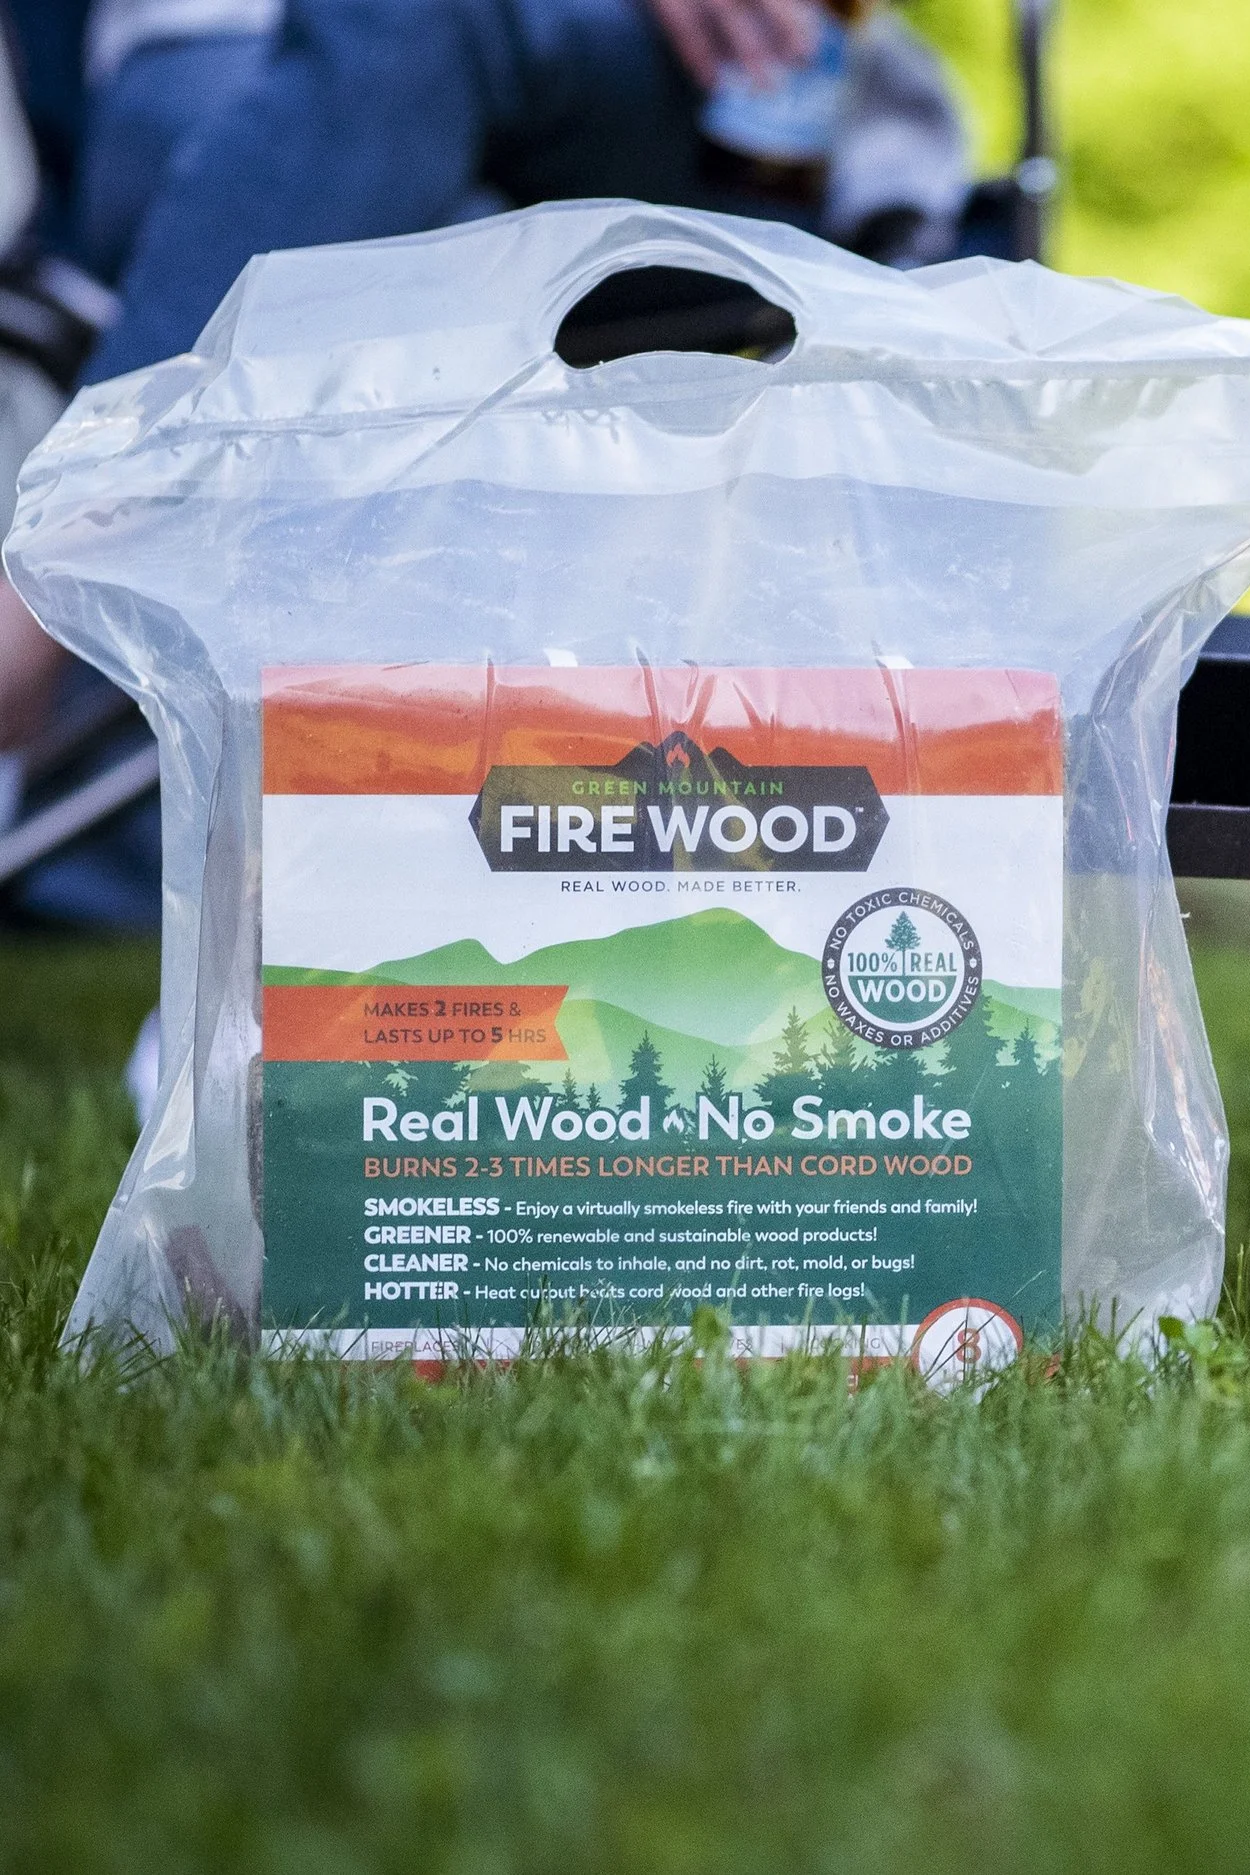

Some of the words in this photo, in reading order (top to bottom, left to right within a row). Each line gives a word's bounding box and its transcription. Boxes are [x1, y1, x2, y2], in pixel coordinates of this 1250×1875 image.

[572, 781, 647, 795] GREEN
[659, 781, 783, 795] MOUNTAIN
[501, 805, 635, 852] FIRE
[561, 881, 604, 892] REAL
[612, 881, 671, 892] WOOD.
[678, 881, 728, 892] MADE
[733, 881, 801, 892] BETTER.
[830, 926, 847, 950] NO
[846, 893, 892, 924] TOXIC
[898, 892, 974, 950] CHEMICALS
[848, 952, 897, 972] 100%
[910, 952, 957, 972] REAL
[857, 979, 946, 1002] WOOD
[364, 1002, 428, 1017] MAKES
[434, 1000, 447, 1017] 2
[452, 1002, 503, 1017] FIRES
[509, 1002, 521, 1016] &
[825, 974, 840, 998] NO
[837, 1001, 884, 1042] WAXES
[891, 1034, 913, 1046] OR
[921, 976, 979, 1043] ADDITIVES
[364, 1029, 422, 1043] LASTS
[428, 1029, 454, 1043] UP
[459, 1029, 485, 1043] TO
[491, 1026, 503, 1043] 5
[508, 1029, 546, 1043] HRS
[363, 1096, 478, 1141] Real
[495, 1096, 650, 1141] Wood
[699, 1095, 774, 1140] No
[791, 1094, 972, 1140] Smoke
[364, 1157, 457, 1178] BURNS
[465, 1157, 503, 1177] 2-3
[509, 1156, 591, 1177] TIMES
[598, 1155, 709, 1177] LONGER
[716, 1155, 792, 1176] THAN
[800, 1155, 878, 1176] CORD
[883, 1155, 973, 1176] WOOD
[364, 1197, 500, 1217] SMOKELESS
[516, 1201, 559, 1219] Enjoy
[563, 1205, 573, 1216] a
[577, 1200, 640, 1219] virtually
[644, 1200, 723, 1215] smokeless
[727, 1200, 753, 1214] fire
[757, 1200, 792, 1214] with
[796, 1203, 830, 1217] your
[833, 1199, 887, 1214] friends
[890, 1199, 921, 1214] and
[925, 1199, 978, 1216] family!
[364, 1226, 471, 1244] GREENER
[487, 1229, 533, 1244] 100%
[537, 1229, 620, 1243] renewable
[623, 1229, 655, 1243] and
[658, 1228, 751, 1242] sustainable
[755, 1228, 799, 1242] wood
[803, 1227, 878, 1244] products!
[364, 1254, 469, 1272] CLEANER
[485, 1258, 508, 1272] No
[512, 1257, 592, 1272] chemicals
[595, 1259, 614, 1271] to
[618, 1257, 671, 1273] inhale,
[675, 1256, 706, 1271] and
[710, 1259, 731, 1271] no
[735, 1255, 768, 1272] dirt,
[771, 1257, 799, 1272] rot,
[803, 1255, 847, 1272] mold,
[851, 1258, 868, 1270] or
[871, 1254, 915, 1273] bugs!
[364, 1281, 459, 1300] HOTTER
[475, 1285, 516, 1299] Heat
[629, 1284, 664, 1299] cord
[716, 1283, 747, 1297] and
[751, 1283, 794, 1297] other
[798, 1283, 825, 1297] fire
[828, 1282, 865, 1300] logs!
[955, 1328, 982, 1363] 8
